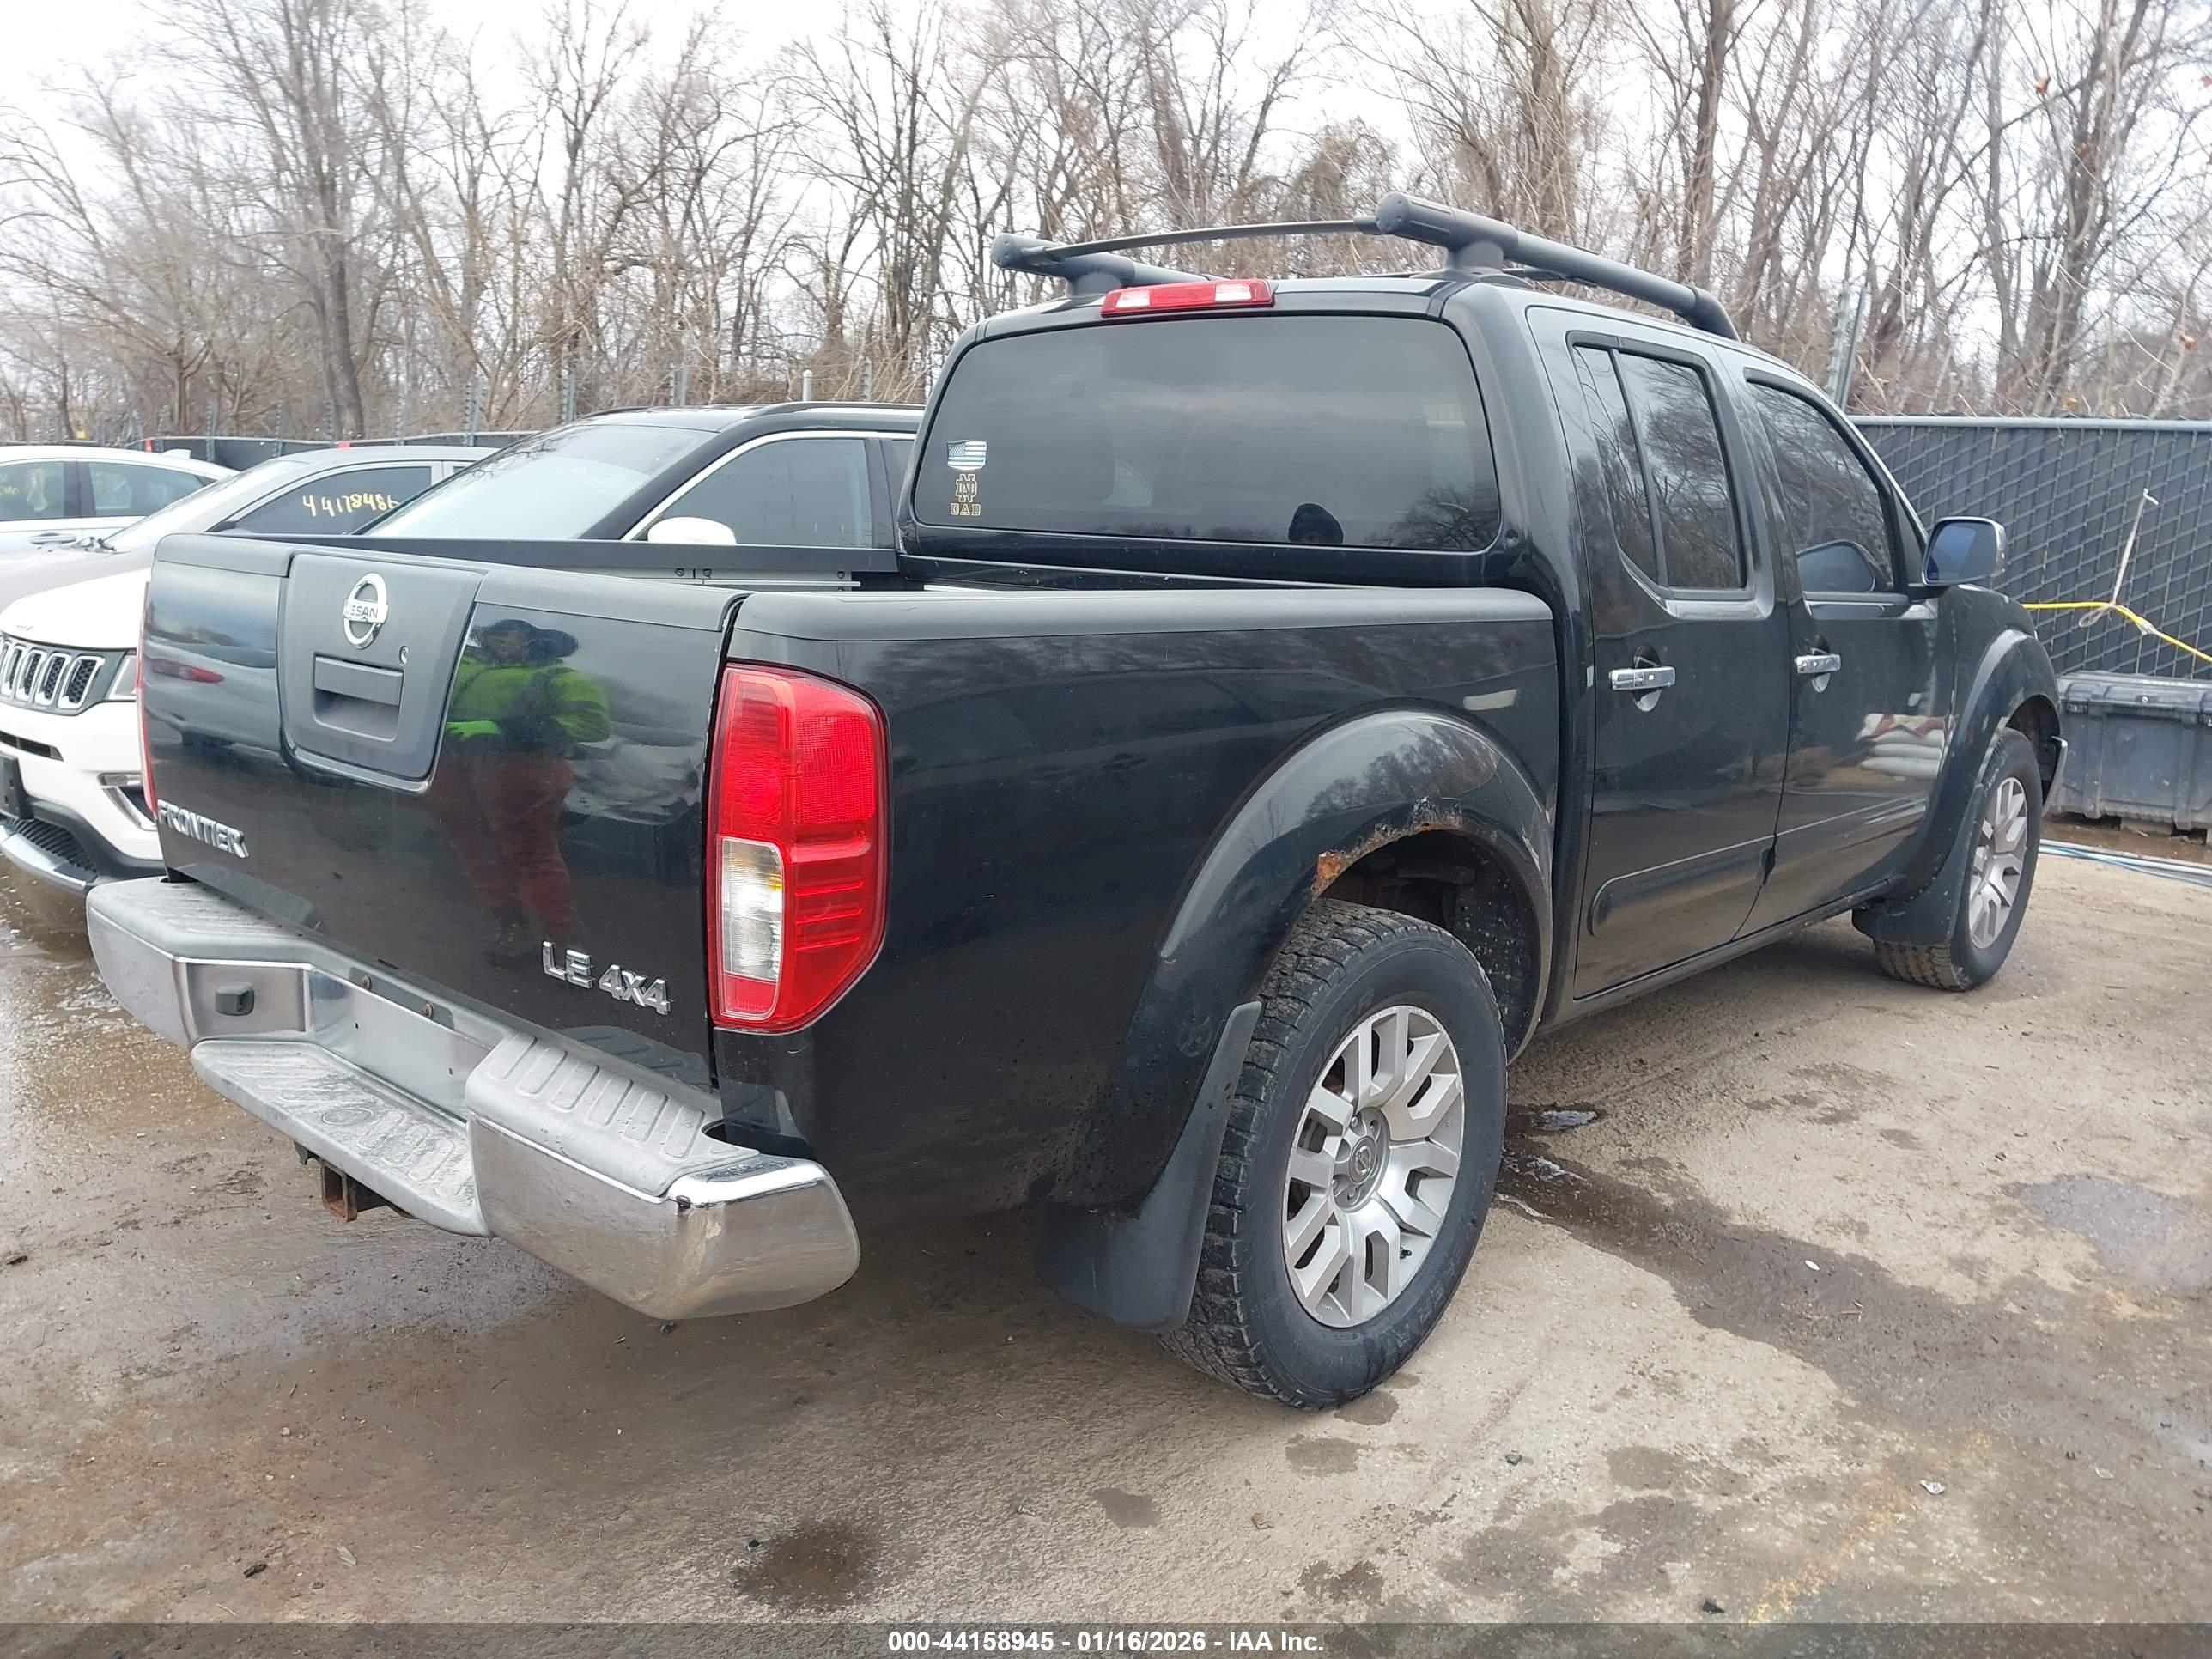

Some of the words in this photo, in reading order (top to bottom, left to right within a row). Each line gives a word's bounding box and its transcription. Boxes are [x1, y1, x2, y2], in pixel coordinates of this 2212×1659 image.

[950, 502, 981, 516] DAD
[157, 799, 249, 859] FRONTIER
[542, 940, 594, 990] LE
